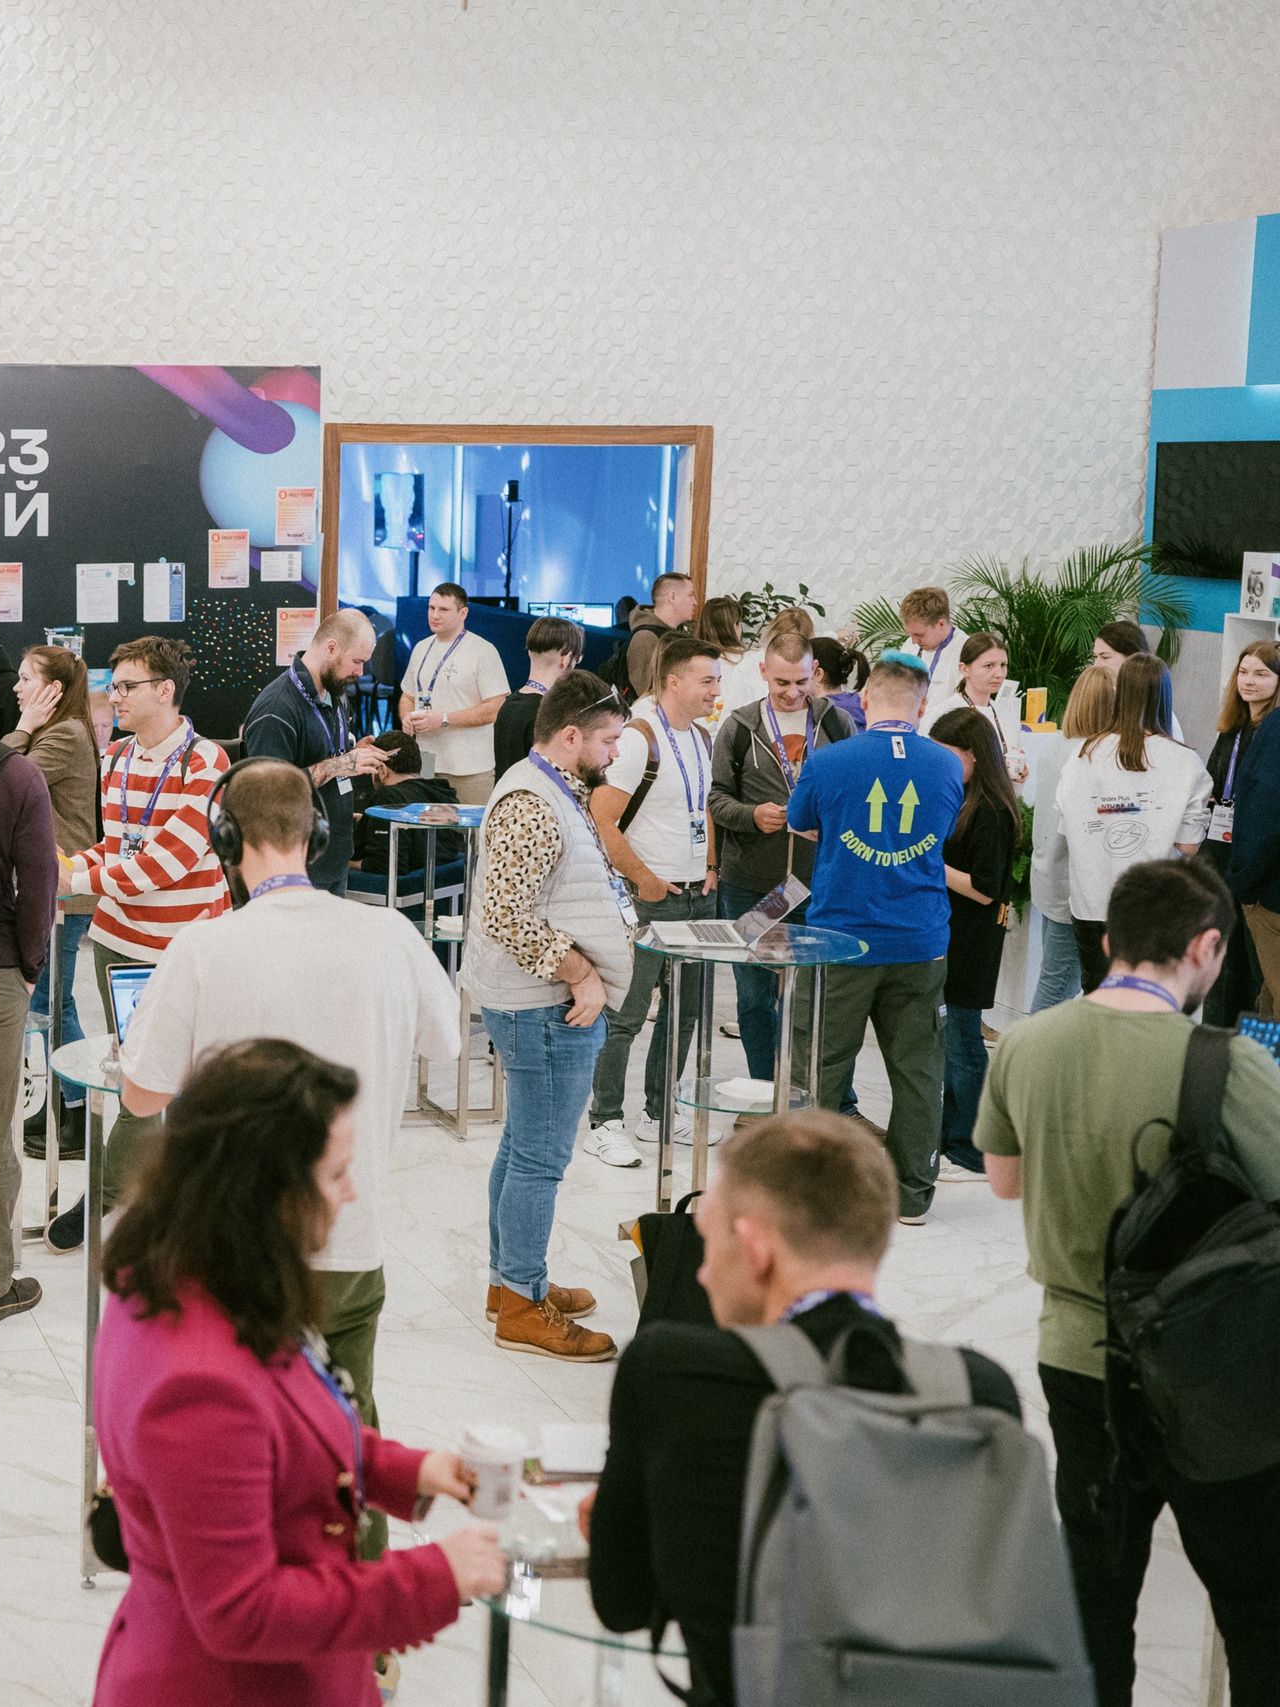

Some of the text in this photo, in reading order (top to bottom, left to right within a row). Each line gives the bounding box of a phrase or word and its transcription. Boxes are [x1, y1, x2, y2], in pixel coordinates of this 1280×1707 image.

[839, 829, 938, 867] BORN TO DELIVER
